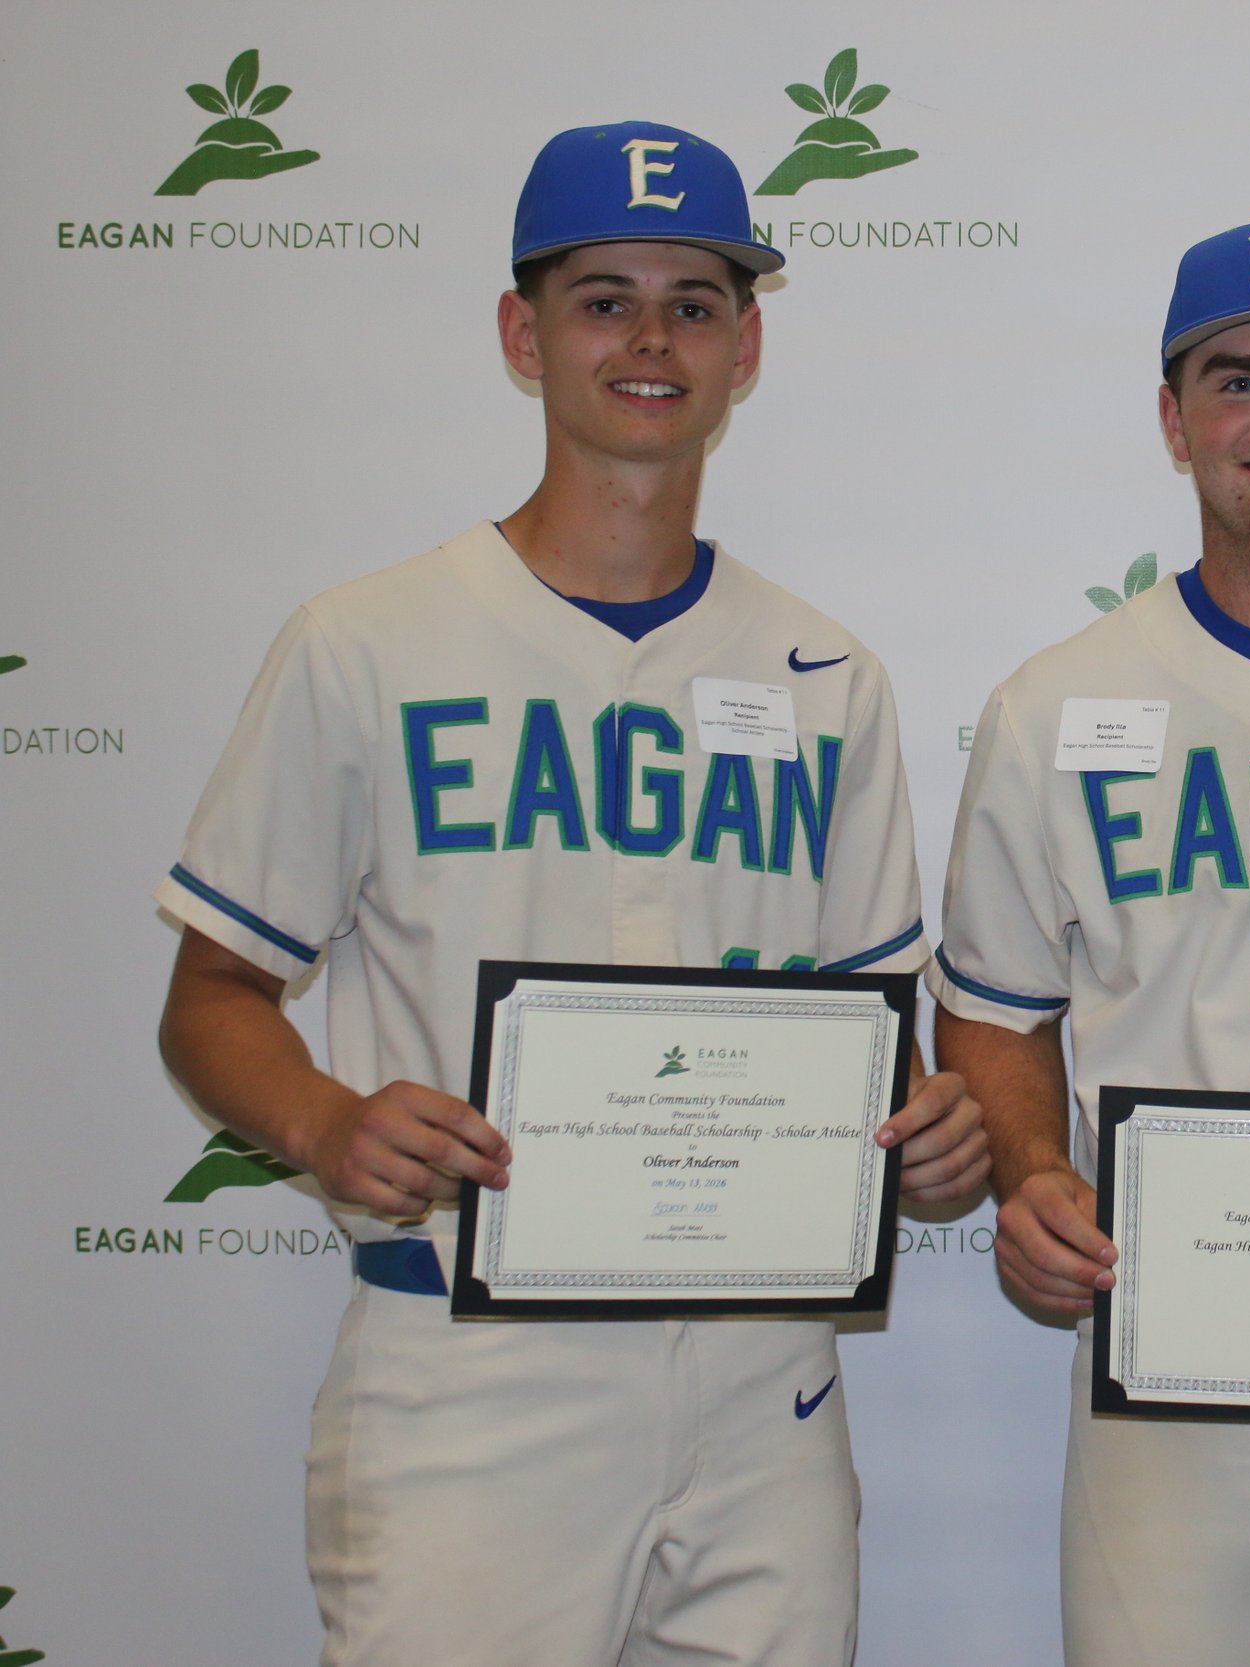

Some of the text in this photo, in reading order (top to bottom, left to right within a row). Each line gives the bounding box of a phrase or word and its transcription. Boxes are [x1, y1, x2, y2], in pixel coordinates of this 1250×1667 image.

[620, 138, 687, 213] E
[58, 222, 419, 249] EAGAN FOUNDATION
[789, 221, 1018, 248] FOUNDATION
[720, 700, 769, 712] Oliver Anderson
[401, 697, 842, 883] EAGAN
[698, 1048, 748, 1059] EAGAN
[606, 1092, 786, 1110] Eagan Community Foundation
[672, 1110, 720, 1120] Presents the
[518, 1121, 560, 1138] Eagan
[563, 1121, 596, 1139] High
[596, 1122, 640, 1137] School
[641, 1122, 695, 1138] Baseball
[694, 1123, 762, 1141] Scholarship
[772, 1125, 817, 1139] Scholar
[817, 1125, 862, 1141] Athlete
[688, 1143, 698, 1151] to
[643, 1154, 740, 1169] Oliver Anderson
[665, 1178, 687, 1190] May
[75, 1227, 183, 1254] EAGAN
[1193, 1239, 1232, 1254] Eagan
